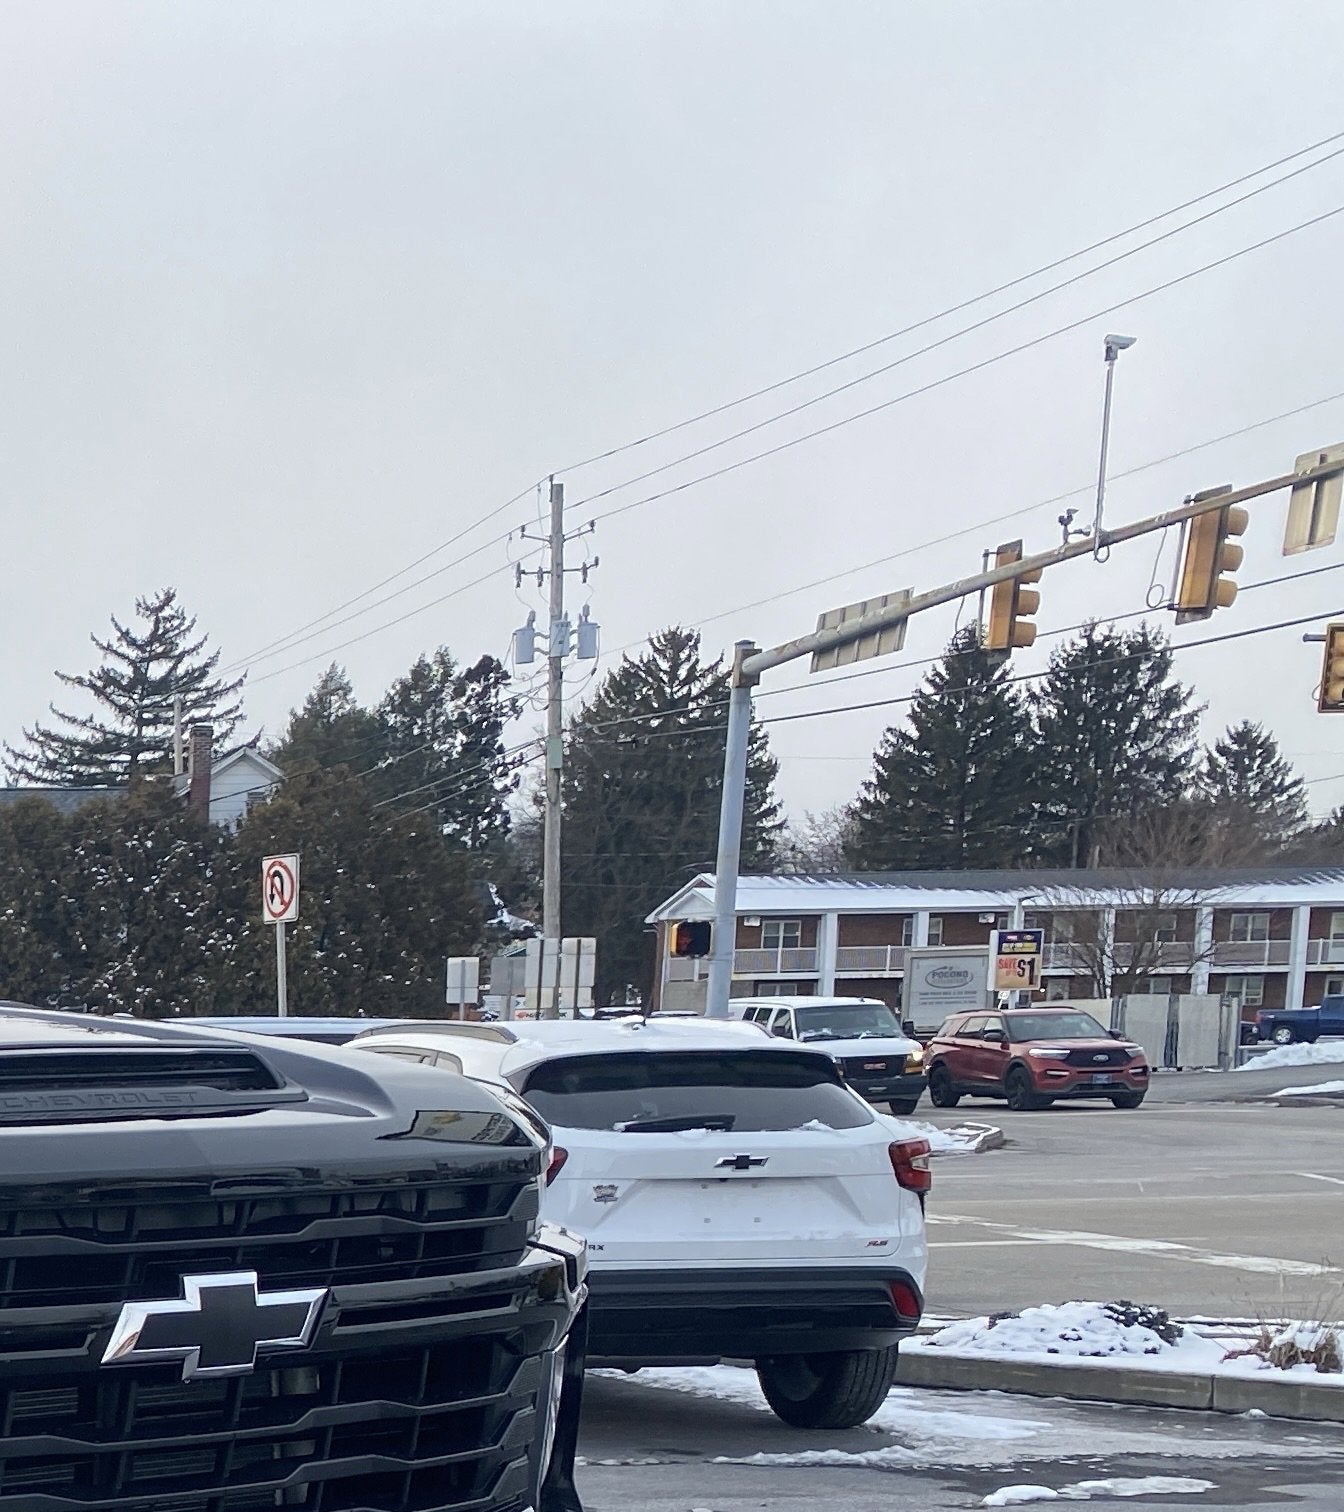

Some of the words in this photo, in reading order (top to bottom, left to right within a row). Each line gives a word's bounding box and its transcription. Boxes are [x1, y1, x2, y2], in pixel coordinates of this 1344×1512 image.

[998, 958, 1017, 970] SAVE
[1017, 957, 1036, 986] $1
[0, 1090, 198, 1109] CHEVROLET
